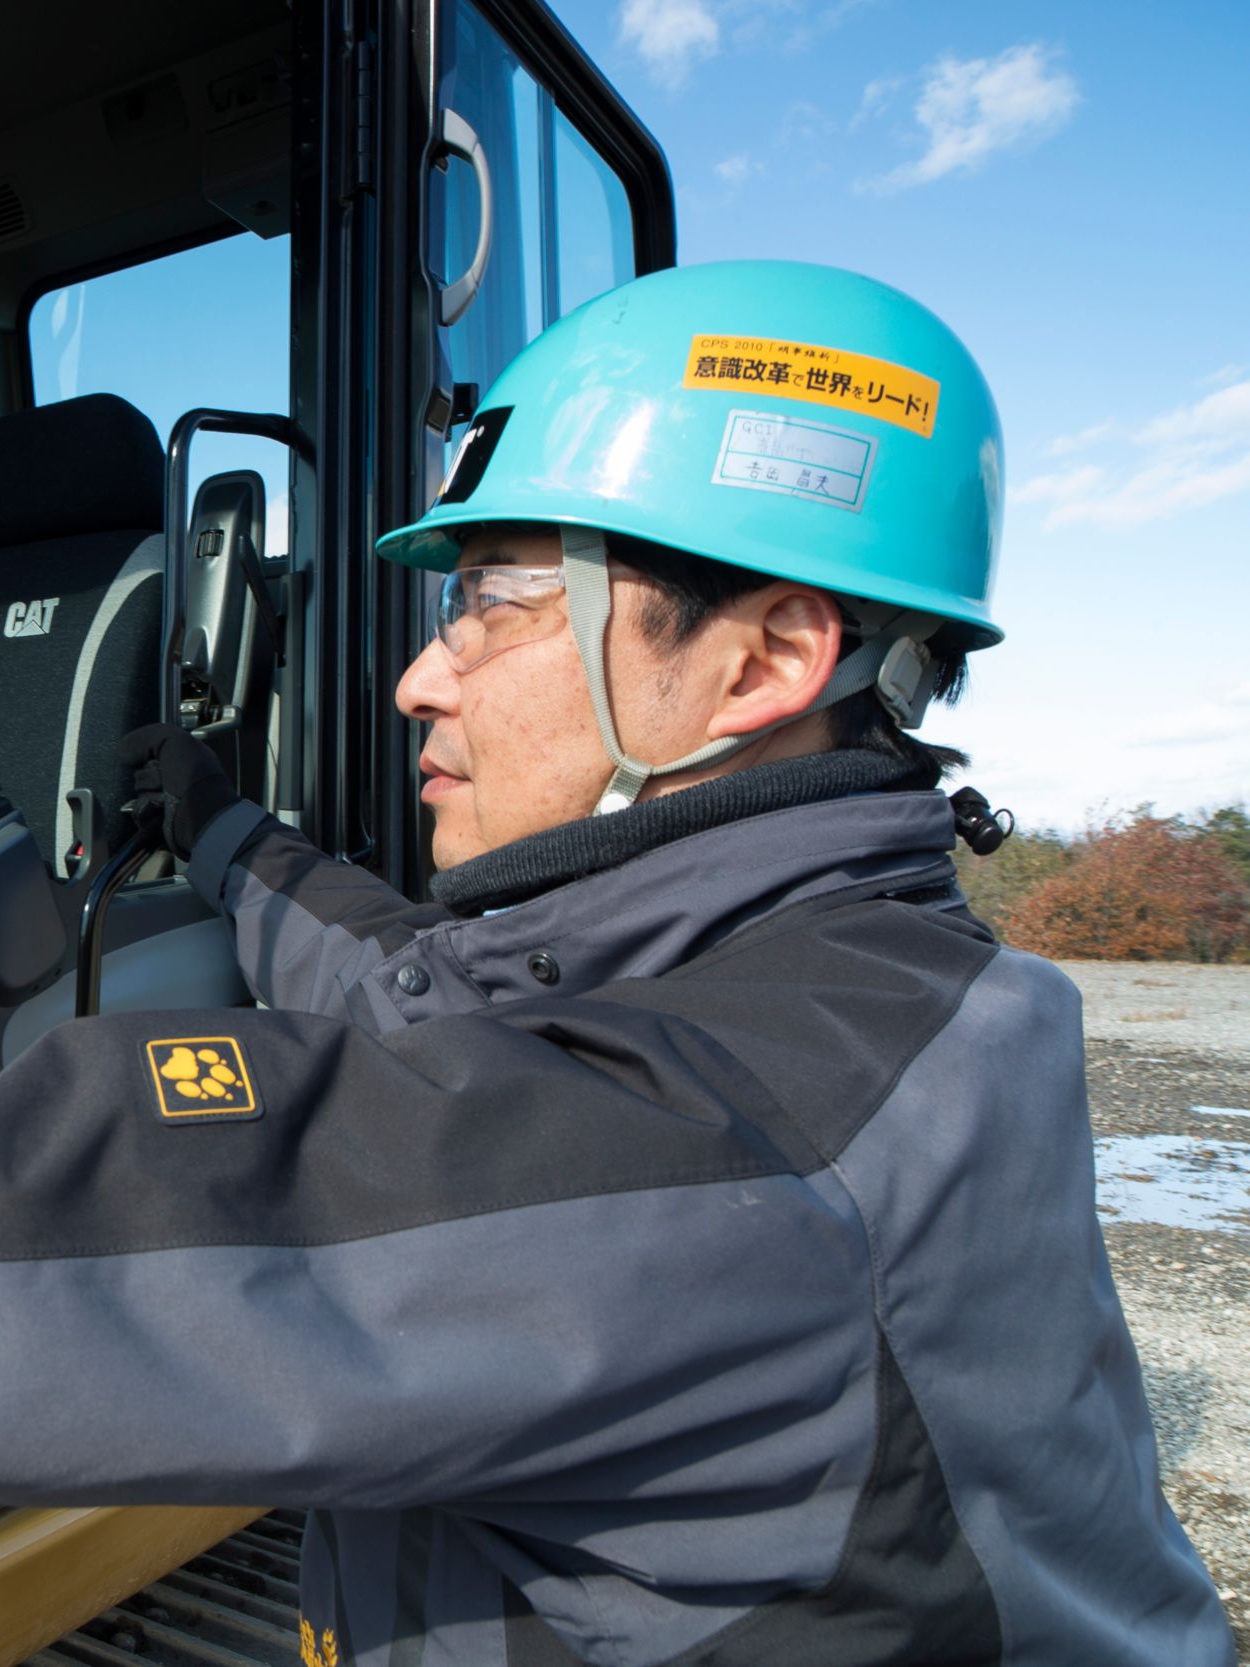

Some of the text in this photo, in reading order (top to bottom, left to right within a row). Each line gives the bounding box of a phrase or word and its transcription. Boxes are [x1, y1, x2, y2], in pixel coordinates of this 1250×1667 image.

[701, 338, 729, 349] CPS
[734, 340, 763, 351] 2010
[4, 597, 60, 638] CAT
